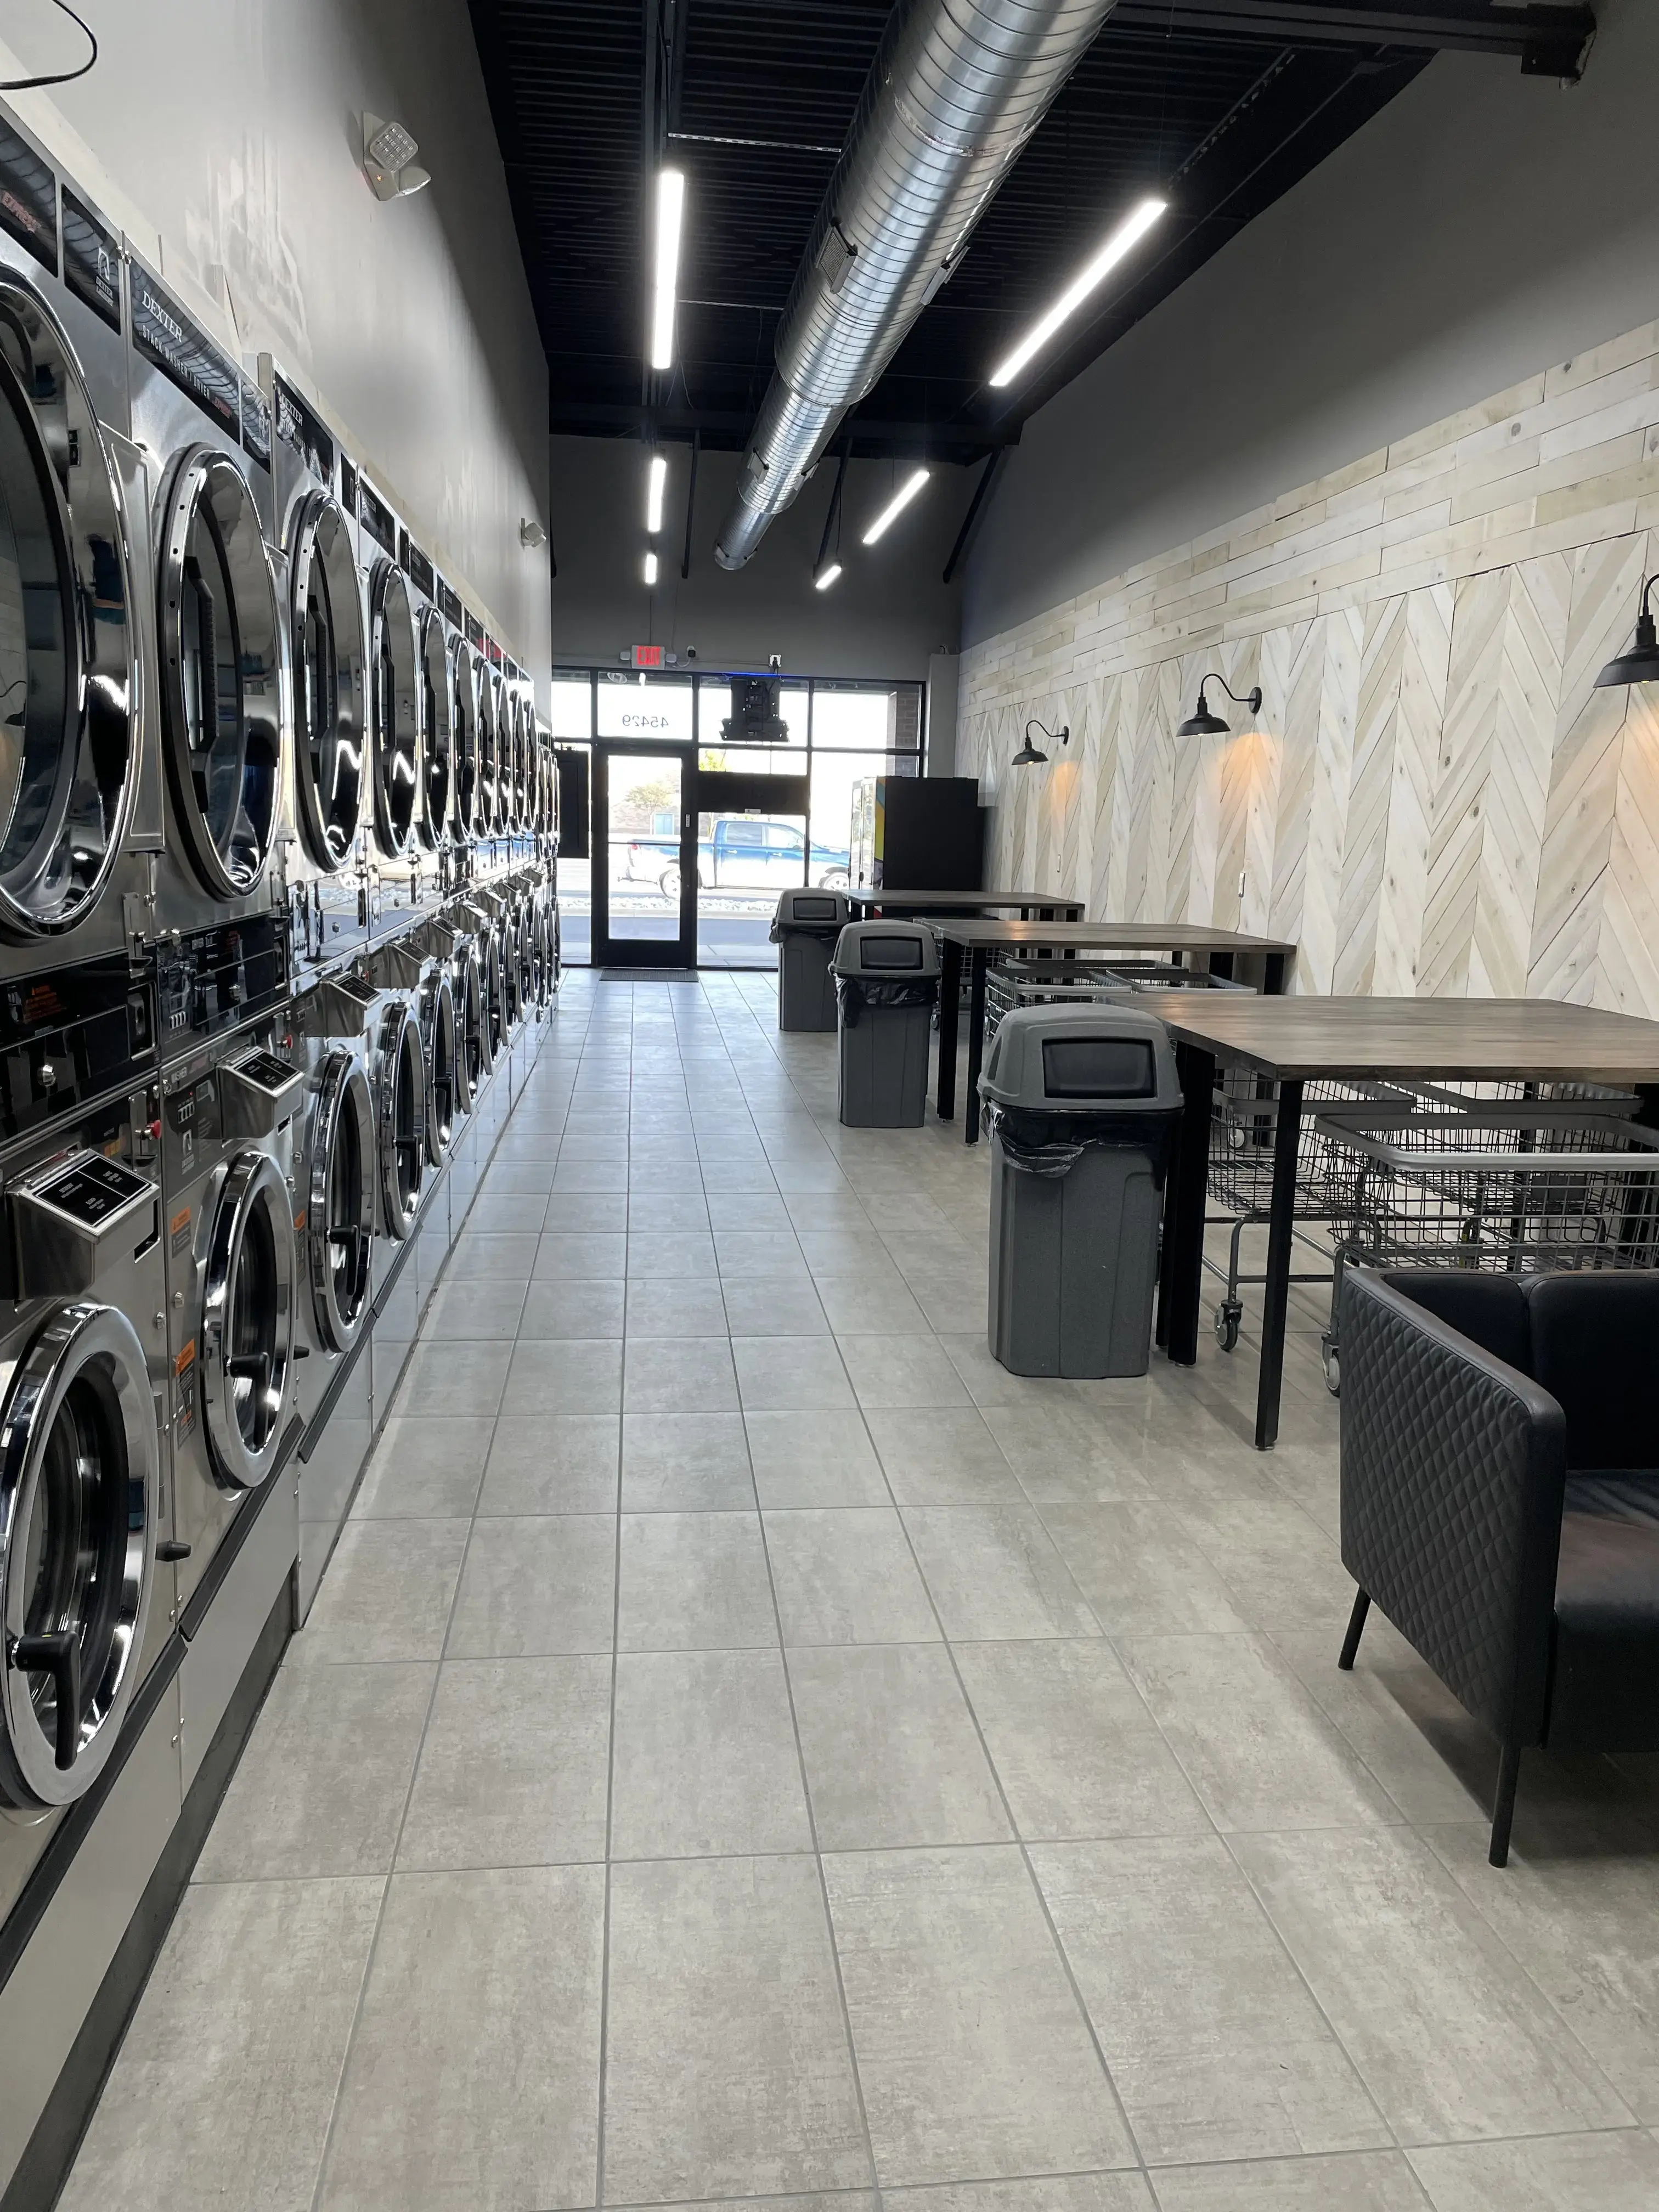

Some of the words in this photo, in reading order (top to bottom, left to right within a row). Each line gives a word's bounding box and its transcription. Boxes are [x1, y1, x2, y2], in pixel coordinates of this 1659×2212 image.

[142, 290, 182, 342] DEXTER
[143, 325, 163, 353] STACK
[281, 393, 303, 426] DEXTER
[637, 646, 661, 665] EXIT
